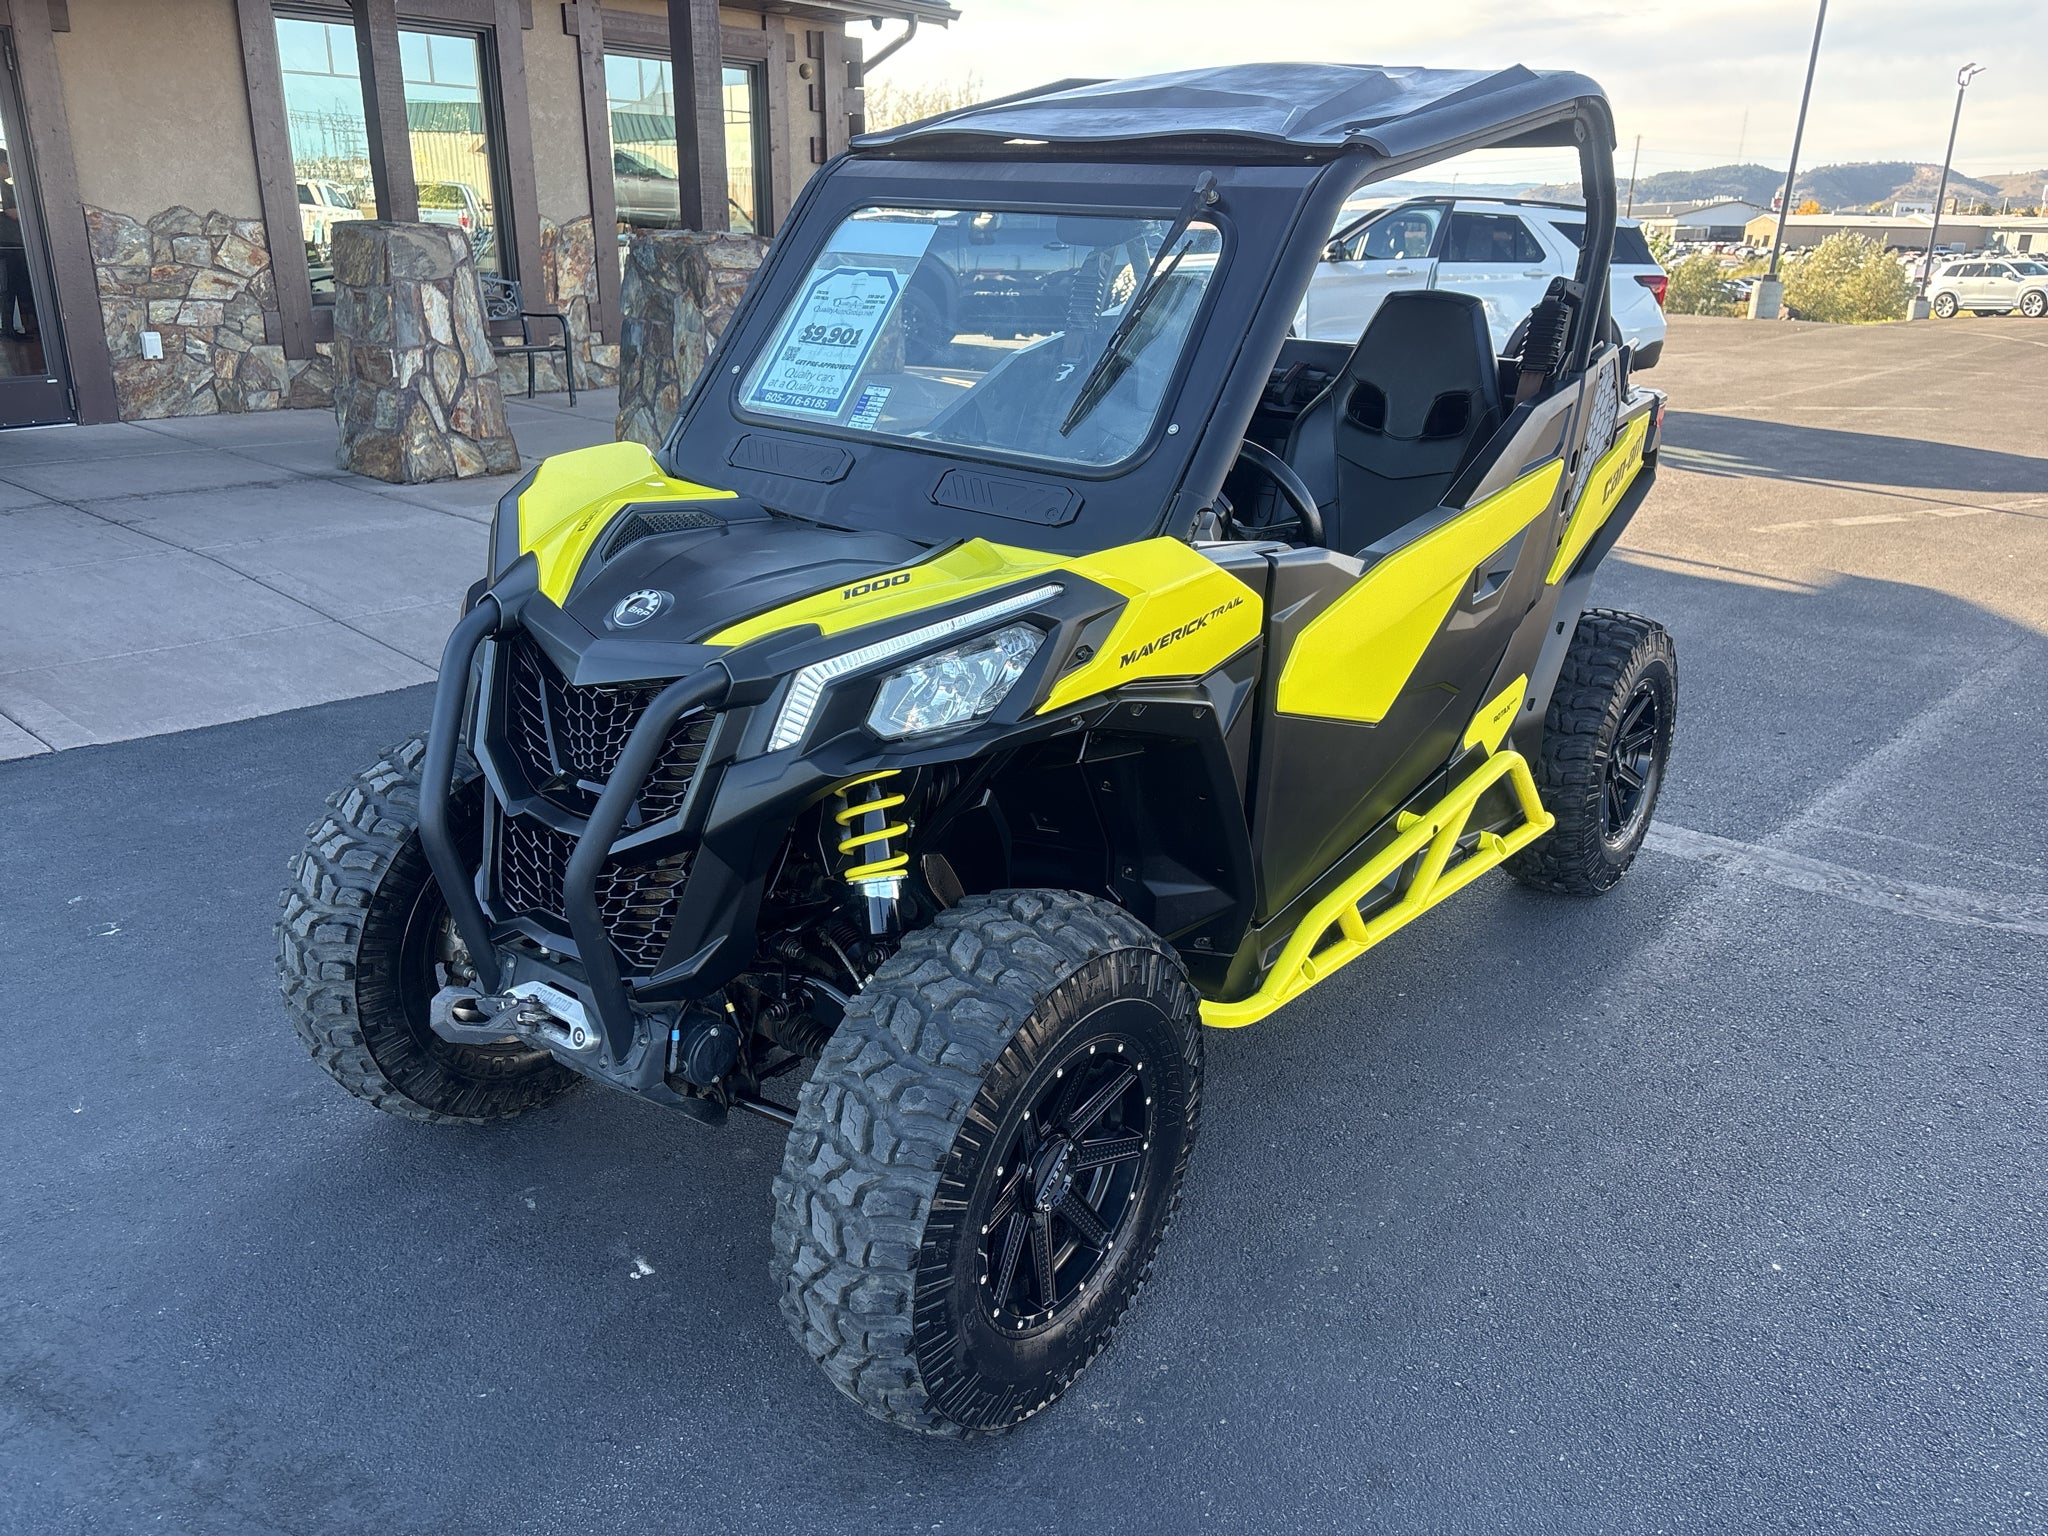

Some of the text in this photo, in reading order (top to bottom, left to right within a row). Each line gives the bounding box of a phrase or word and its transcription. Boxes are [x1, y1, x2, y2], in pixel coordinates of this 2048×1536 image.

[800, 322, 864, 345] $9,901
[784, 367, 836, 383] Quality cars
[768, 379, 778, 387] at
[786, 380, 817, 394] Quality
[815, 384, 840, 396] price
[764, 392, 829, 409] 605-716-6185
[843, 573, 910, 600] 1000
[627, 605, 651, 616] BRP
[1119, 596, 1244, 669] MAVERICK TRAIL
